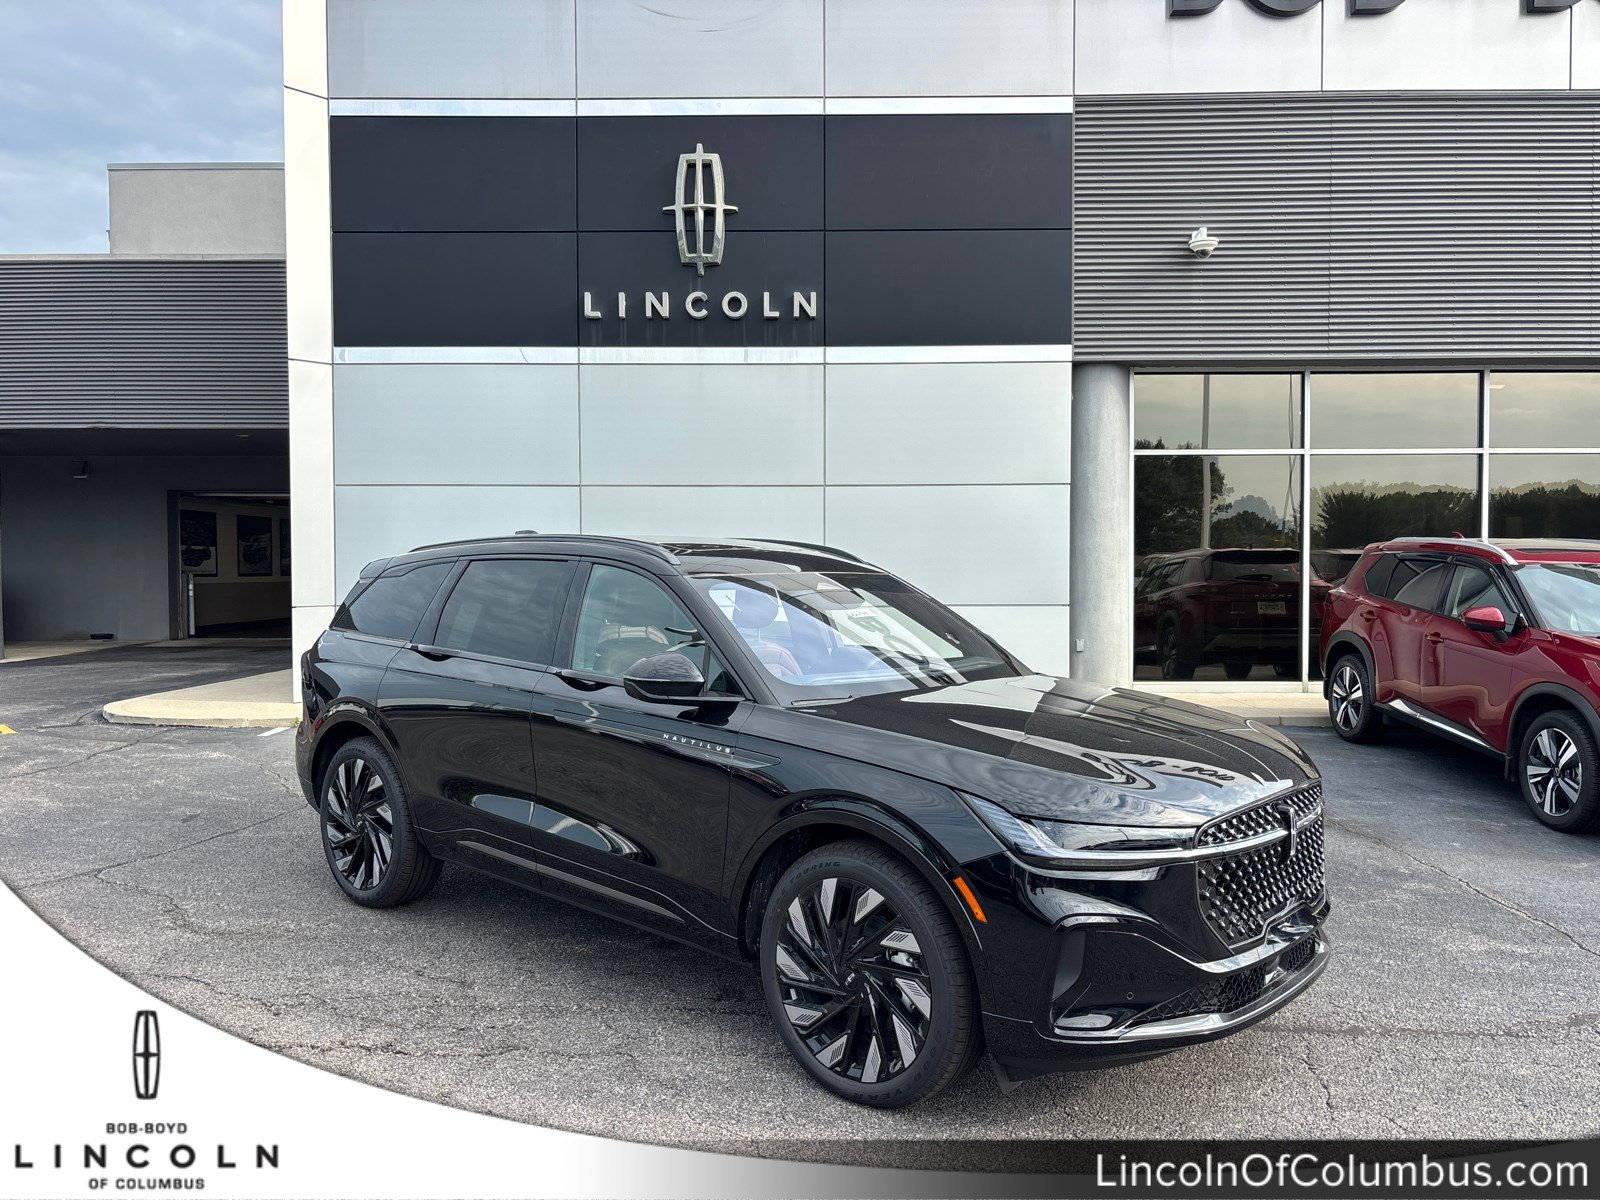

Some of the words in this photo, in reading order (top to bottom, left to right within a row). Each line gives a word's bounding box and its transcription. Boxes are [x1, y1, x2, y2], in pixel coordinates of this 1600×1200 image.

[584, 291, 817, 319] LINCOLN
[663, 733, 731, 754] NAUTILUS
[790, 861, 841, 885] TOURING
